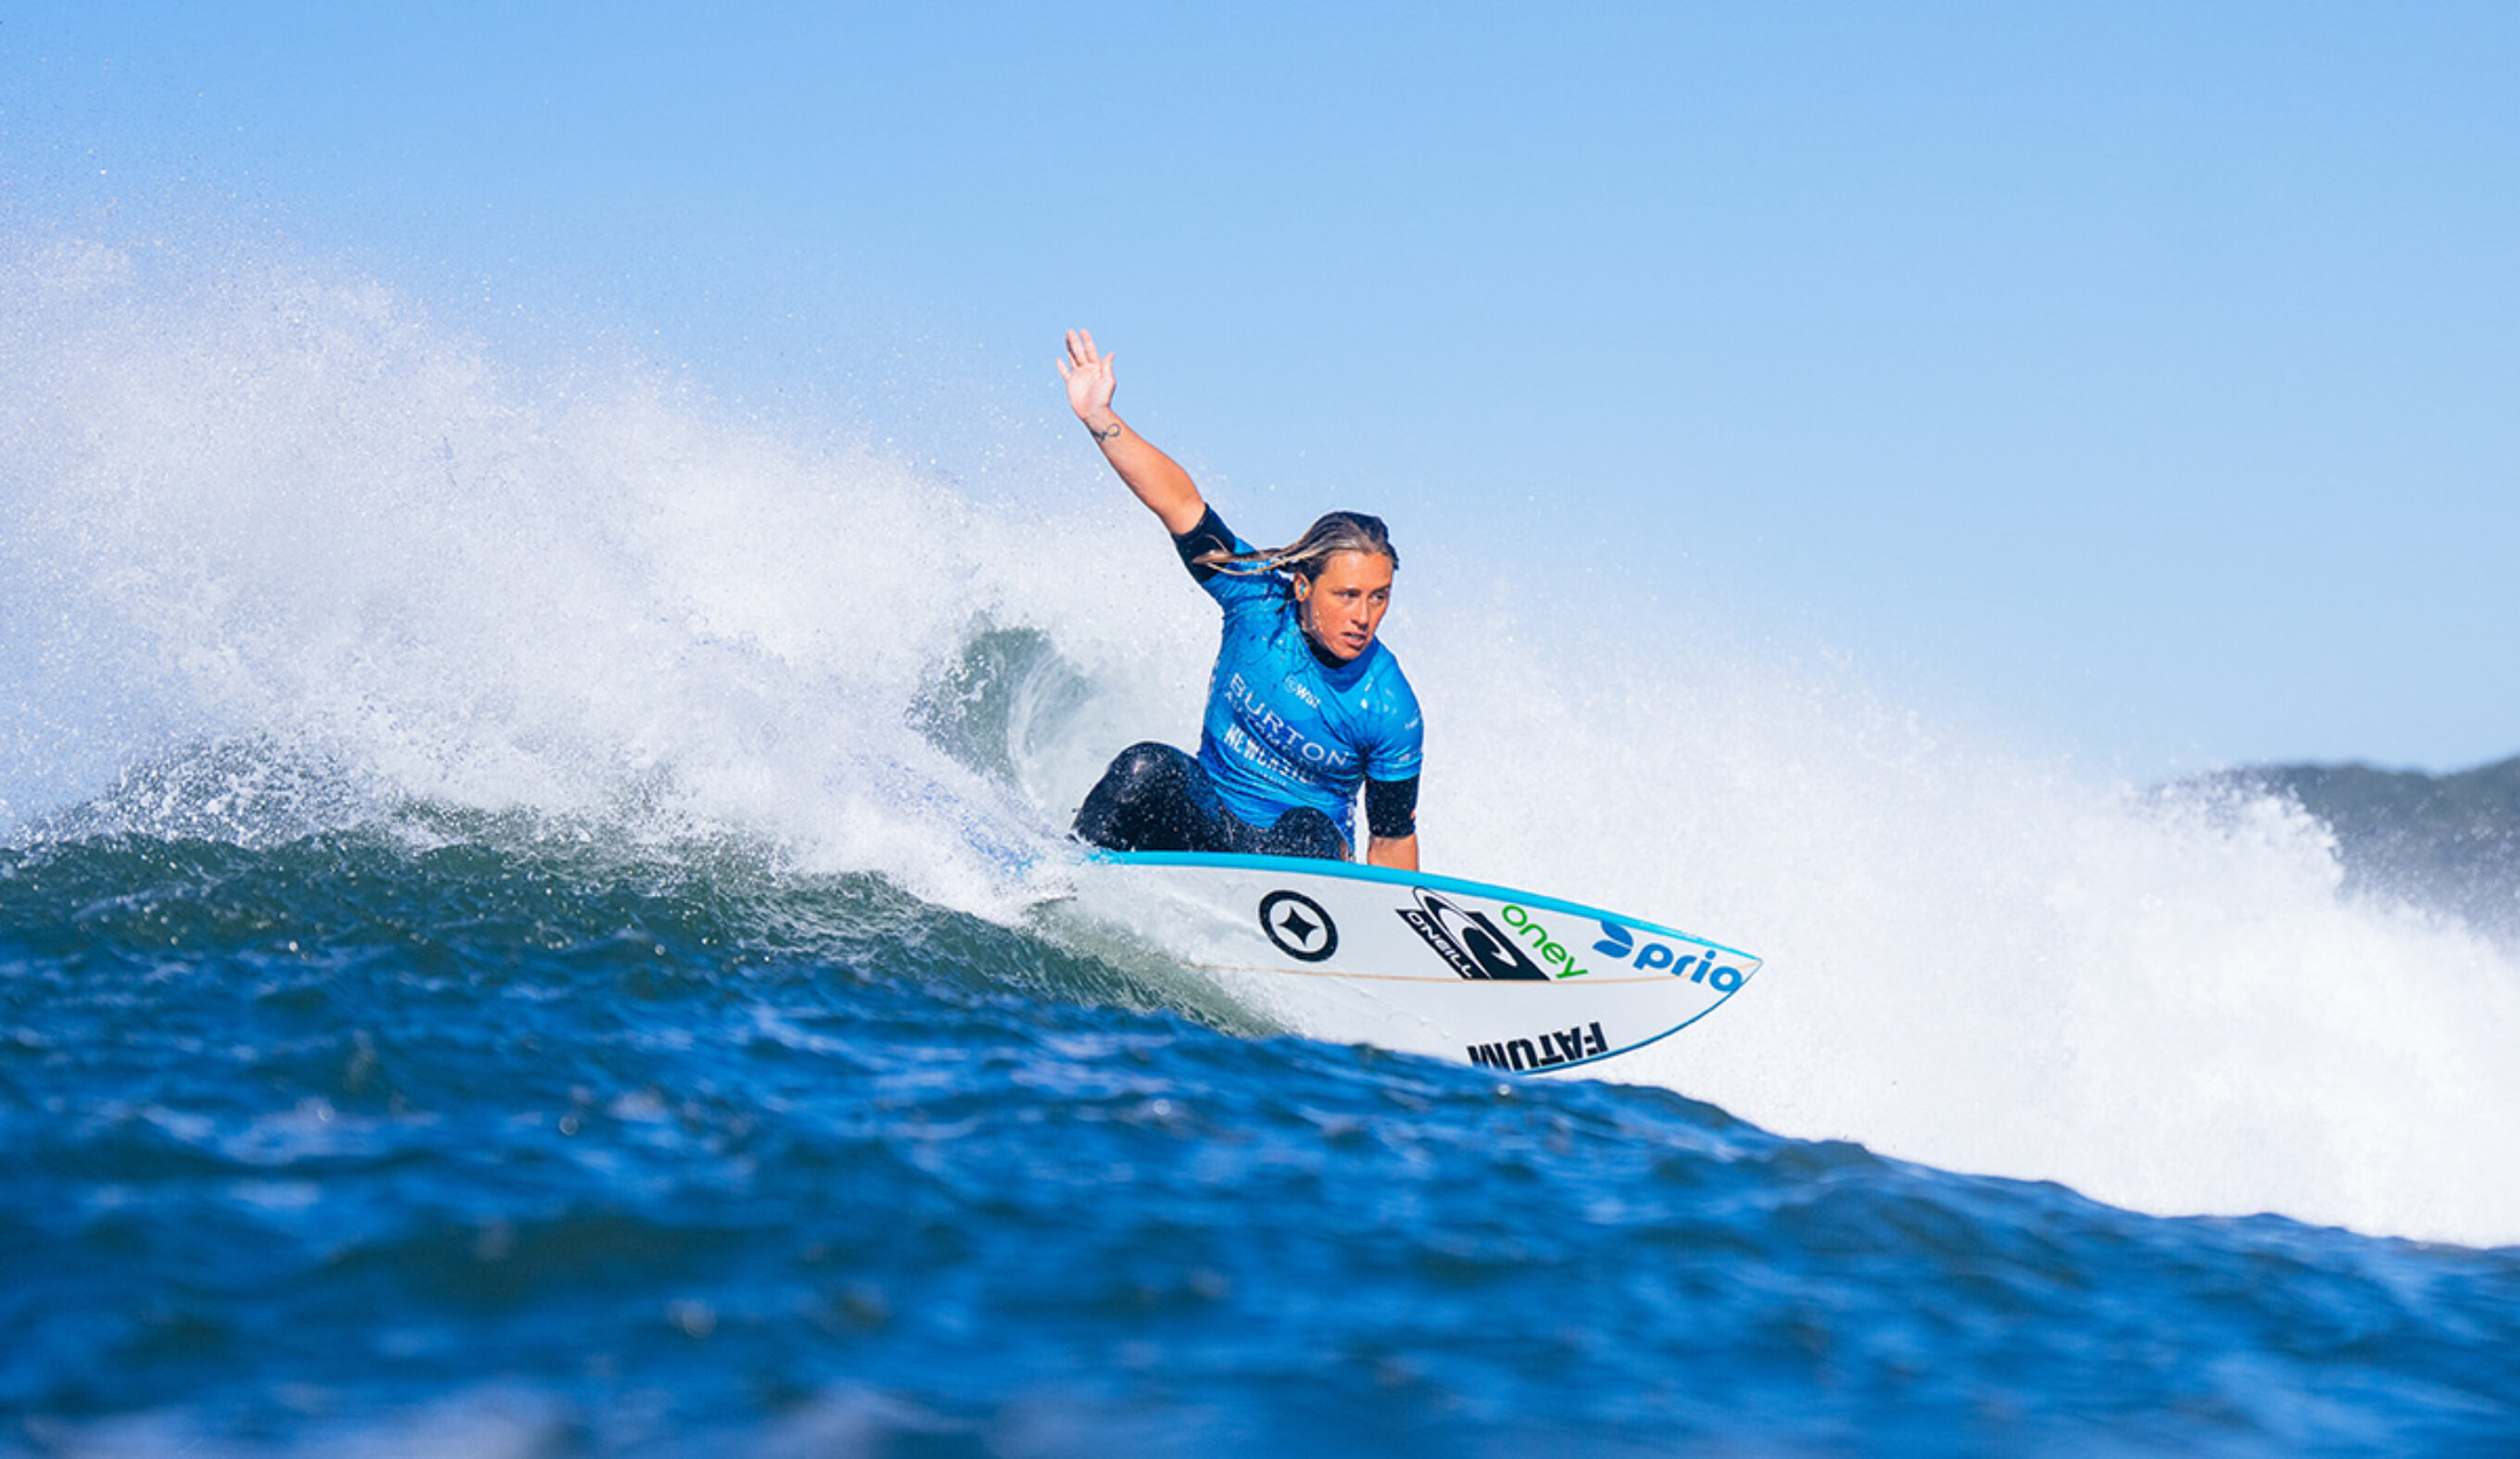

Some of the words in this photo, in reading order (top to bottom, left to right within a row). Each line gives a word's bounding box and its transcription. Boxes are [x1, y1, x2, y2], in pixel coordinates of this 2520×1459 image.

[1230, 673, 1349, 766] BURTON
[1501, 905, 1588, 979] oney
[1633, 943, 1743, 992] prio
[1466, 1022, 1608, 1072] FATUM
